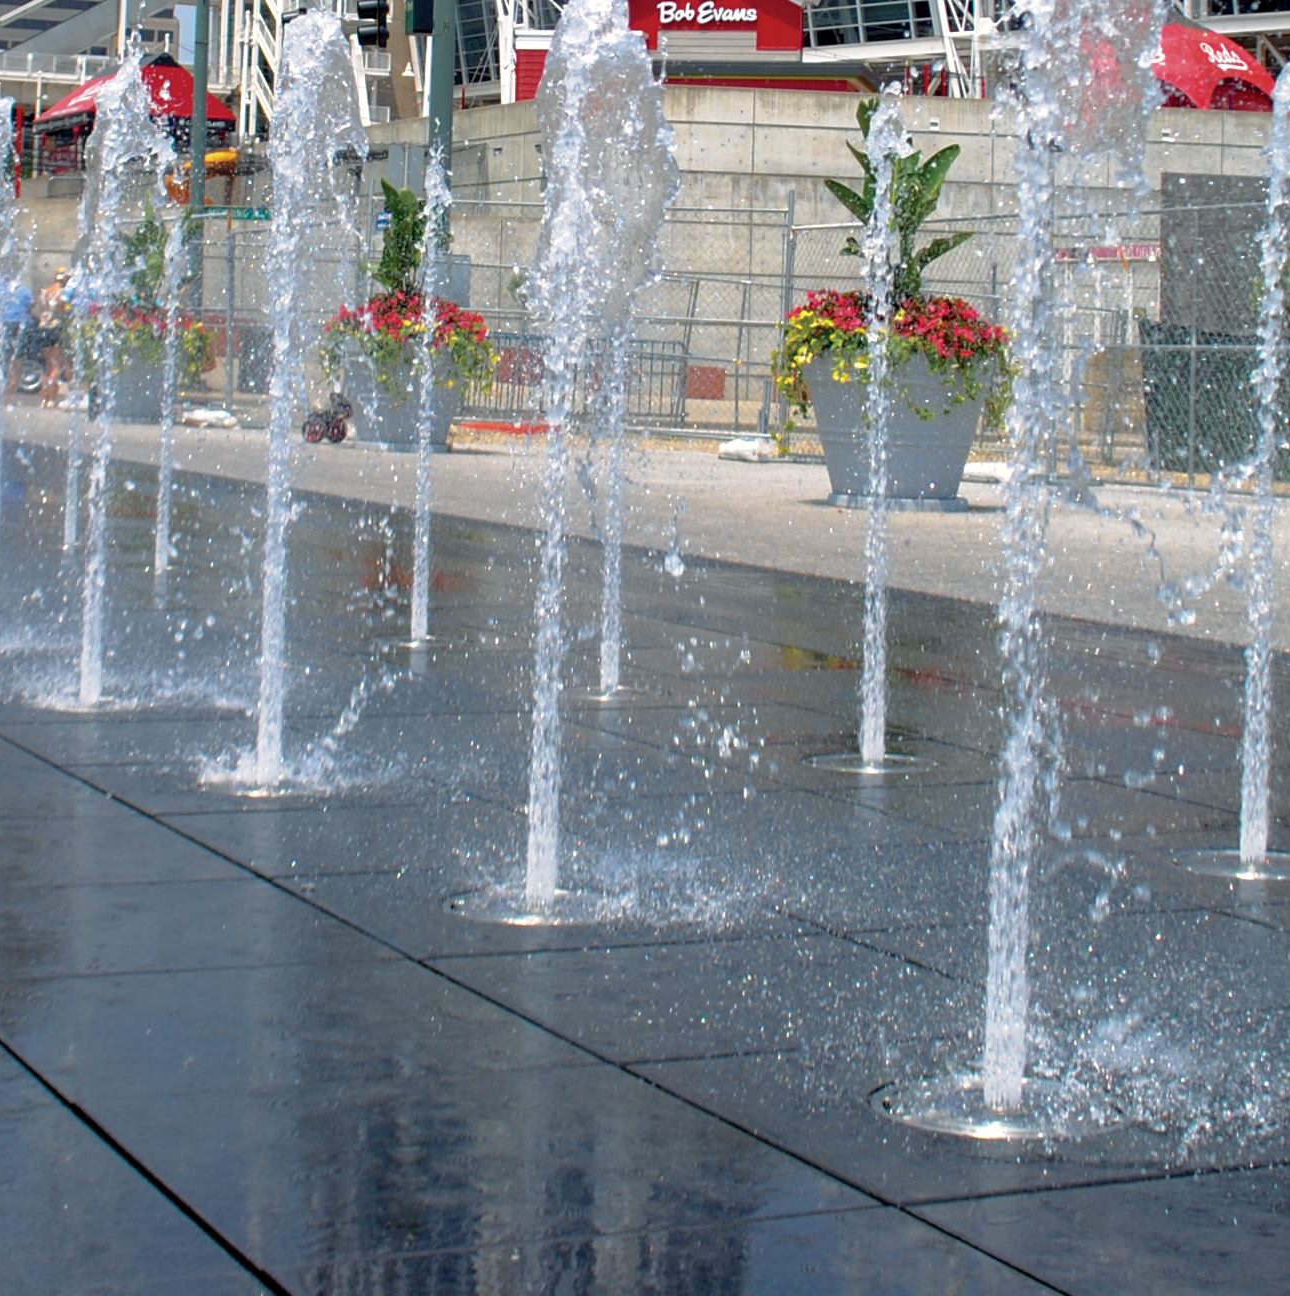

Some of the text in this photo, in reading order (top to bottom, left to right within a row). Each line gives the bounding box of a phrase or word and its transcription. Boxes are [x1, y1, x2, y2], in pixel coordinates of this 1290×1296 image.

[657, 1, 757, 24] Bob Evans
[1200, 42, 1248, 71] Reds
